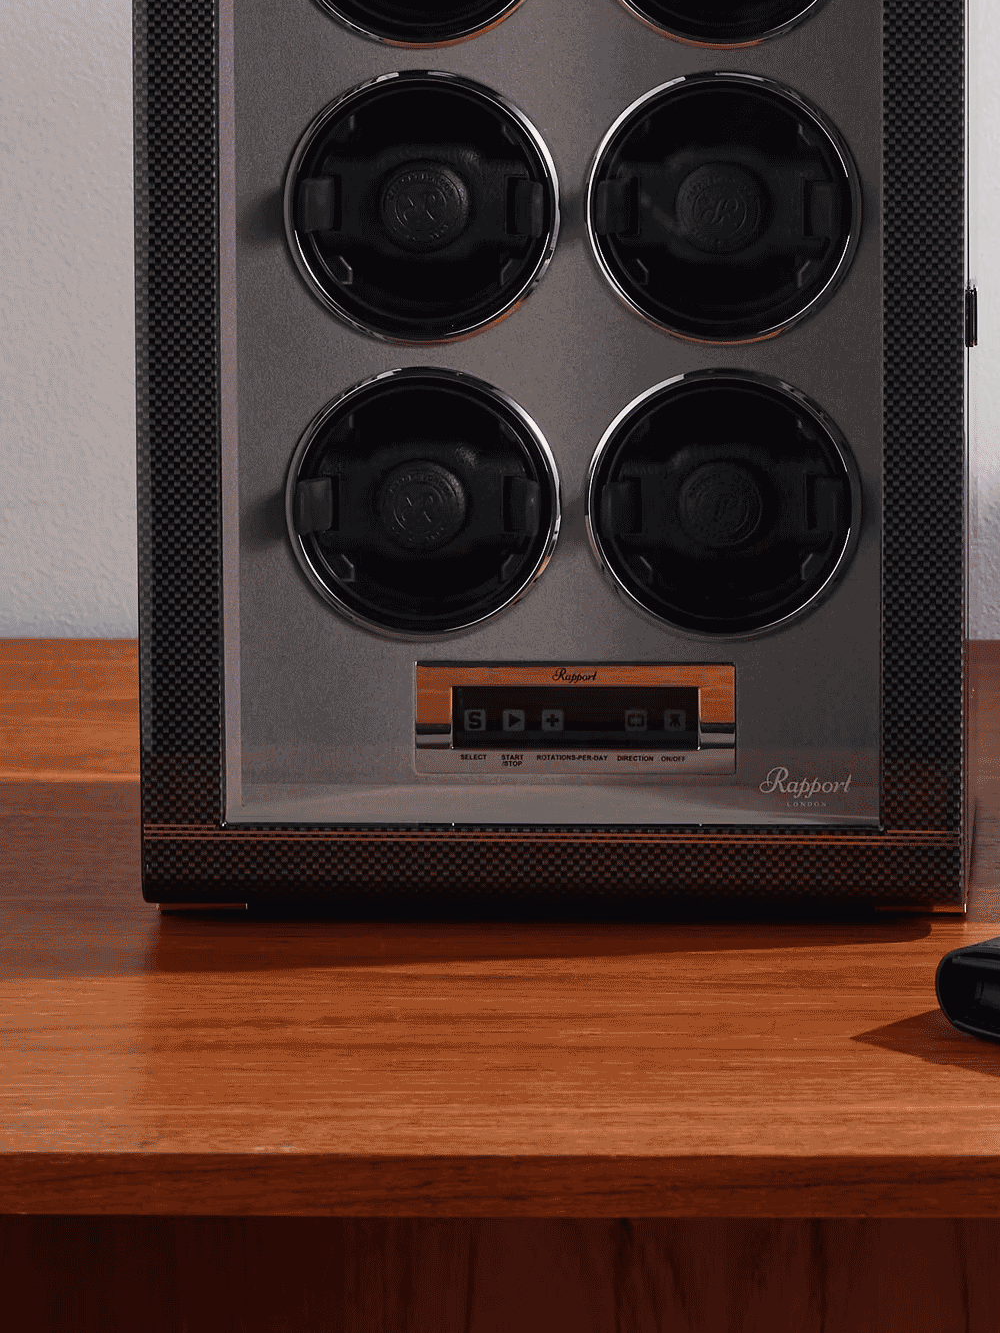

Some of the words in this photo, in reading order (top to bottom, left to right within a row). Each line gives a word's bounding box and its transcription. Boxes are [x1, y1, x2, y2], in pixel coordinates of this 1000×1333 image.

[552, 667, 598, 684] Rapport
[536, 754, 608, 762] ROTATIONS-PER-DAY
[759, 766, 852, 798] Rapport
